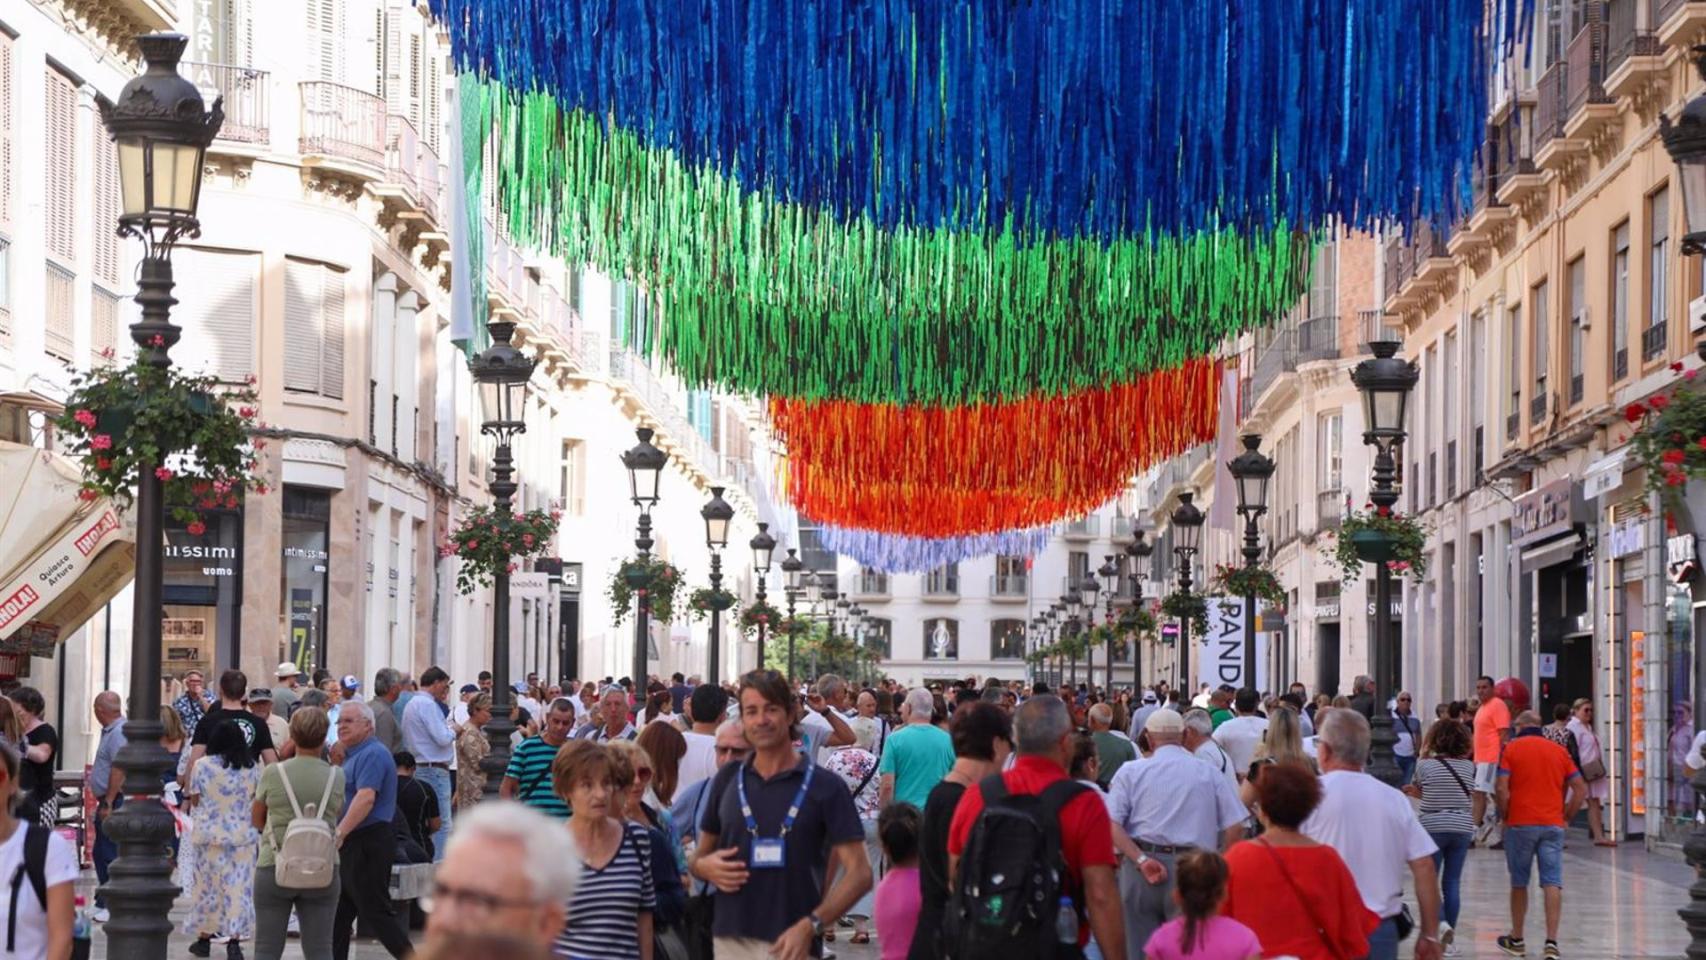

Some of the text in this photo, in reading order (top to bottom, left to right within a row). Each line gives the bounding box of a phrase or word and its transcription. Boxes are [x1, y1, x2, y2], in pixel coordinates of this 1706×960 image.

[48, 563, 74, 587] Arturo
[202, 567, 233, 576] uomo
[0, 585, 37, 627] HOLA!
